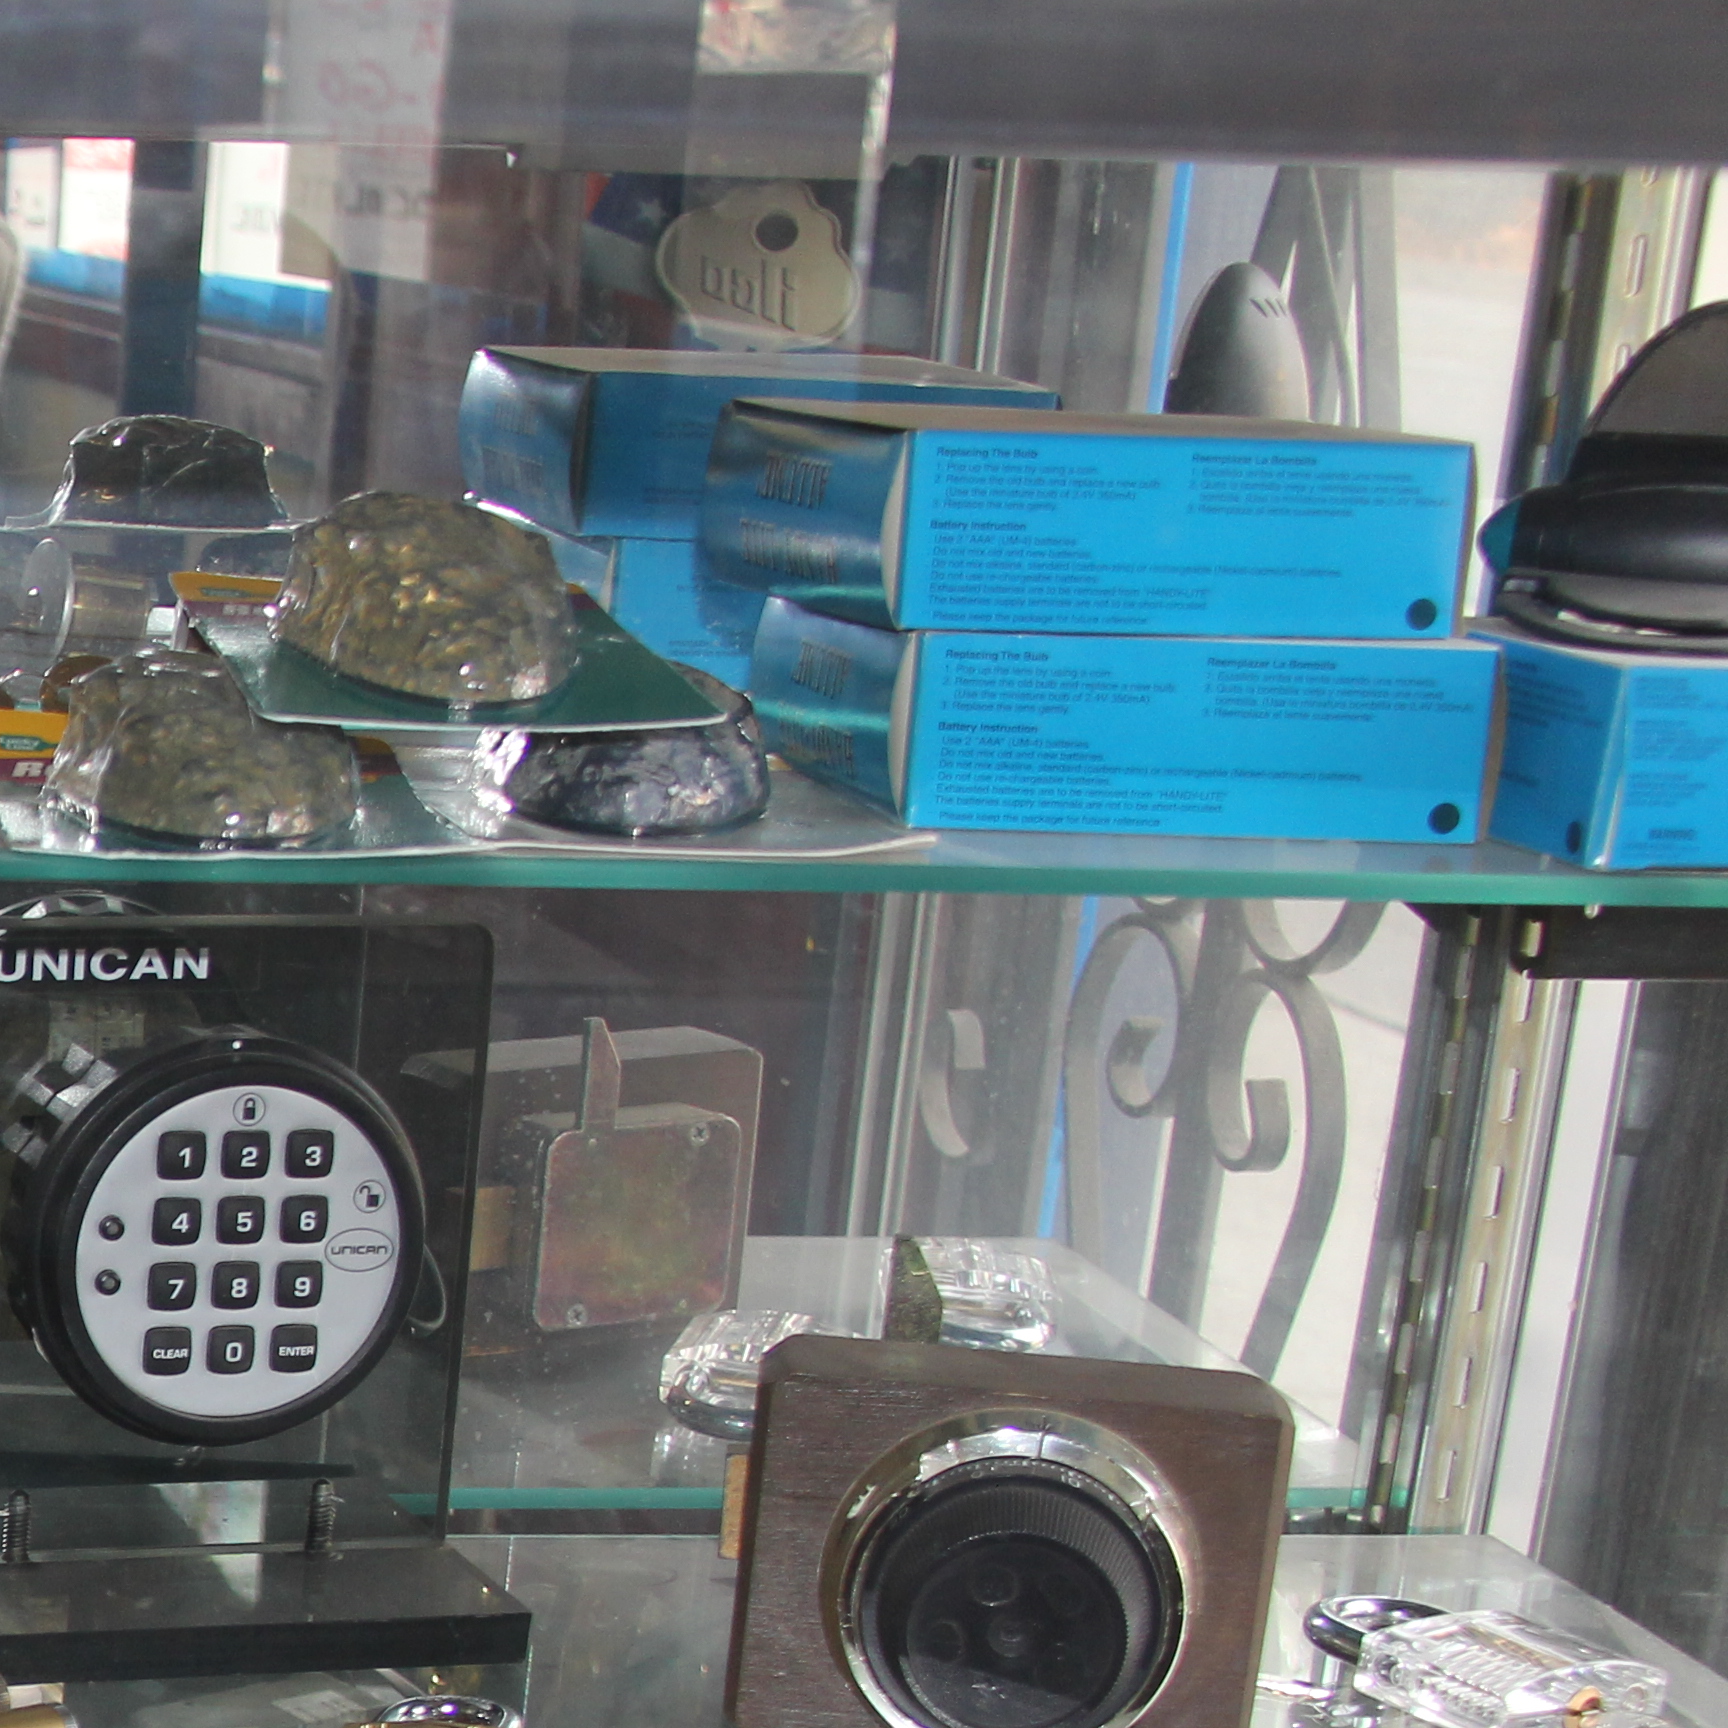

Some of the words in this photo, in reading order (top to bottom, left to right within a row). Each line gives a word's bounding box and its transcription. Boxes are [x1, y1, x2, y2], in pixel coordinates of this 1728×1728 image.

[178, 1147, 192, 1168] 1
[240, 1147, 258, 1167] 2
[304, 1146, 322, 1166] 3
[171, 1212, 189, 1233] 4
[235, 1212, 253, 1232] 5
[299, 1211, 316, 1231] 6
[331, 1245, 388, 1256] UNICAN
[168, 1279, 185, 1299] 7
[230, 1277, 247, 1298] 8
[294, 1277, 311, 1297] 9
[153, 1348, 188, 1360] CLEAR
[225, 1341, 242, 1362] 0
[278, 1345, 314, 1358] ENTER
